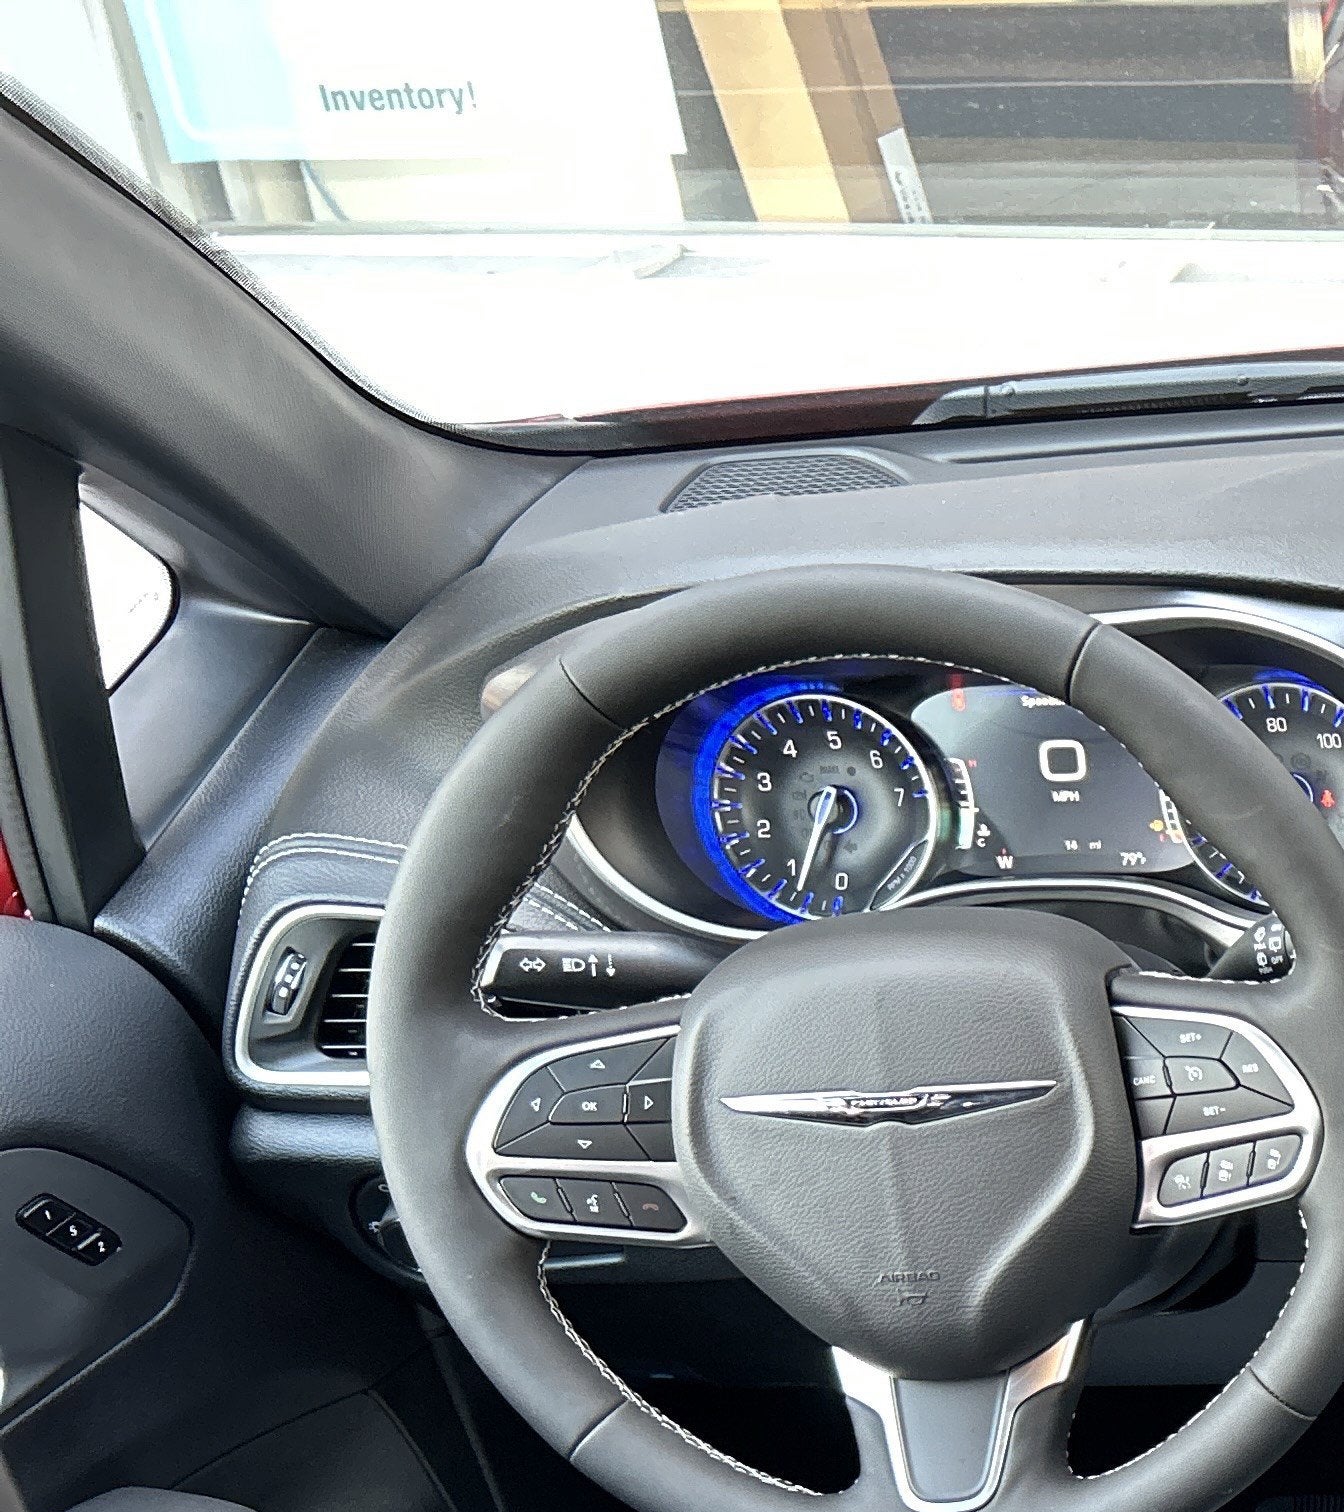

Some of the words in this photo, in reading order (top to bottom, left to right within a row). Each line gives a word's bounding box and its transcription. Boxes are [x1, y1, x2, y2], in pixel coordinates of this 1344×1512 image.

[318, 80, 477, 115] Inventory!
[1265, 717, 1288, 733] 80
[782, 739, 798, 758] 4
[826, 731, 842, 750] 5
[1316, 732, 1343, 749] 100
[869, 750, 883, 769] 6
[1038, 739, 1087, 783] 0
[757, 772, 773, 792] 3
[893, 787, 905, 807] 7
[1051, 790, 1081, 803] MPH
[756, 819, 772, 839] 2
[786, 858, 797, 877] 1
[995, 854, 1014, 870] W
[834, 872, 849, 890] 0
[581, 1101, 598, 1112] OK
